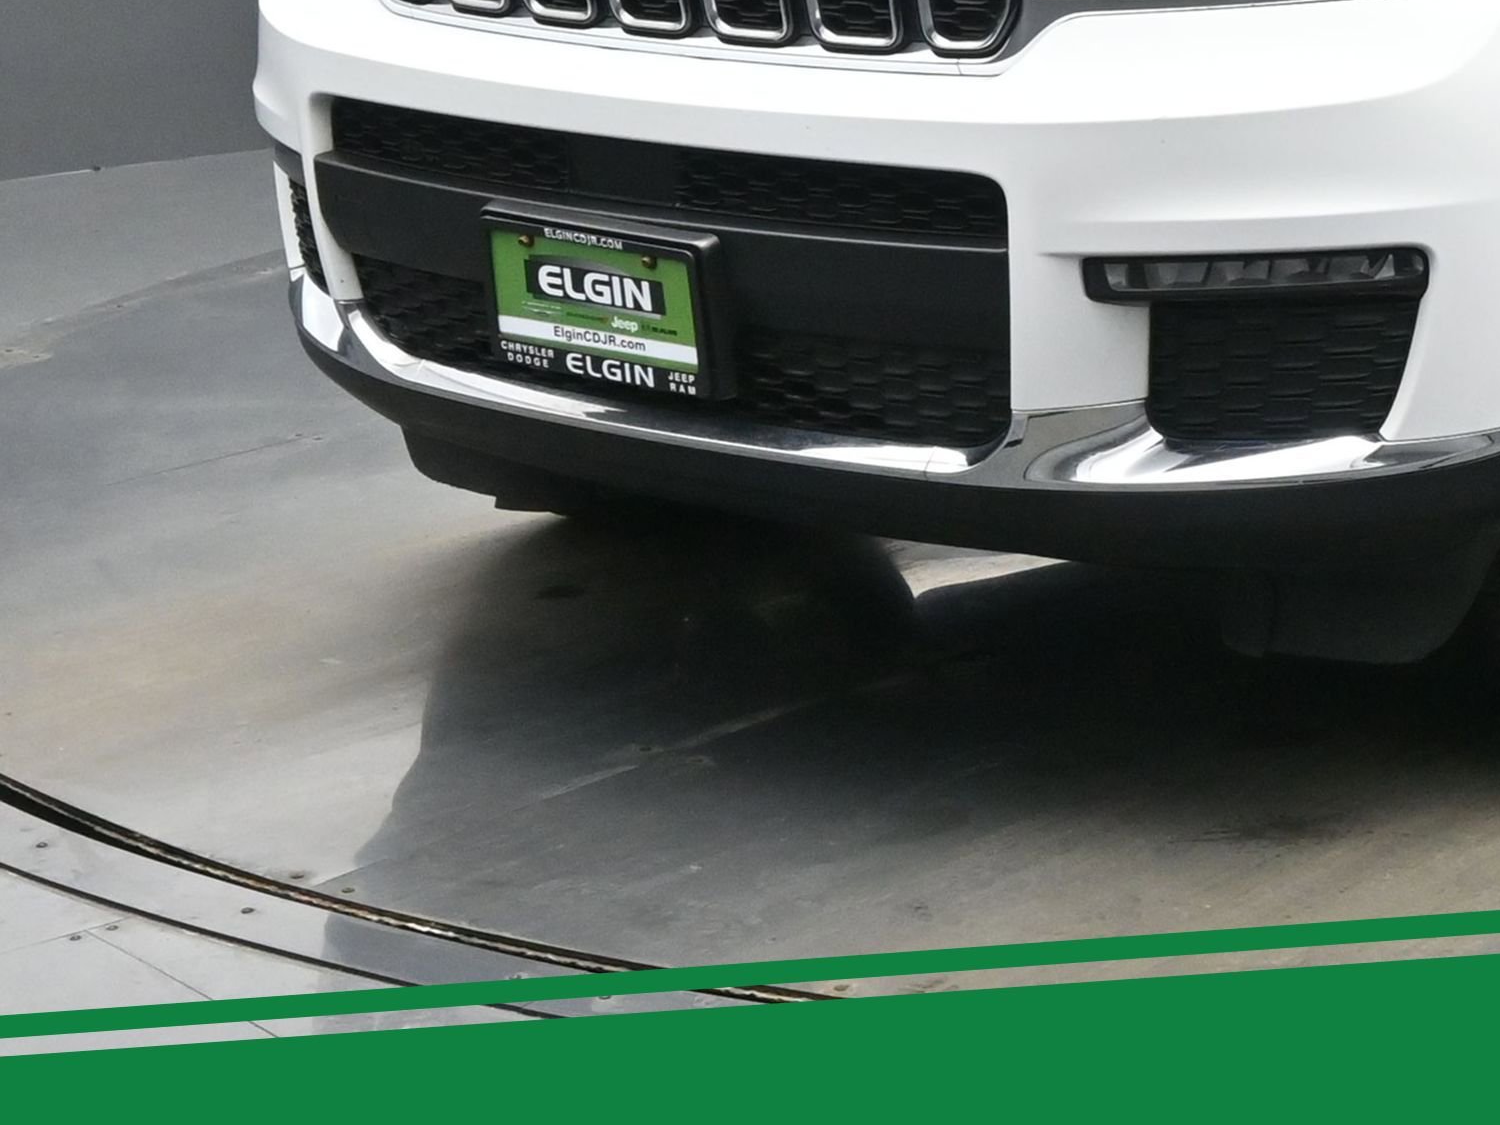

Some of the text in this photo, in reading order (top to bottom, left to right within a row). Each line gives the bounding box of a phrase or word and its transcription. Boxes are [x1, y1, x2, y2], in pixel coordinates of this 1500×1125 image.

[537, 264, 653, 312] ELGIN
[610, 315, 639, 334] Jeep
[553, 325, 646, 352] ElginCDJR.com
[501, 340, 555, 359] CHRYSLER
[507, 352, 550, 369] DODGE
[565, 352, 655, 389] ELGIN
[667, 371, 696, 385] JEEP
